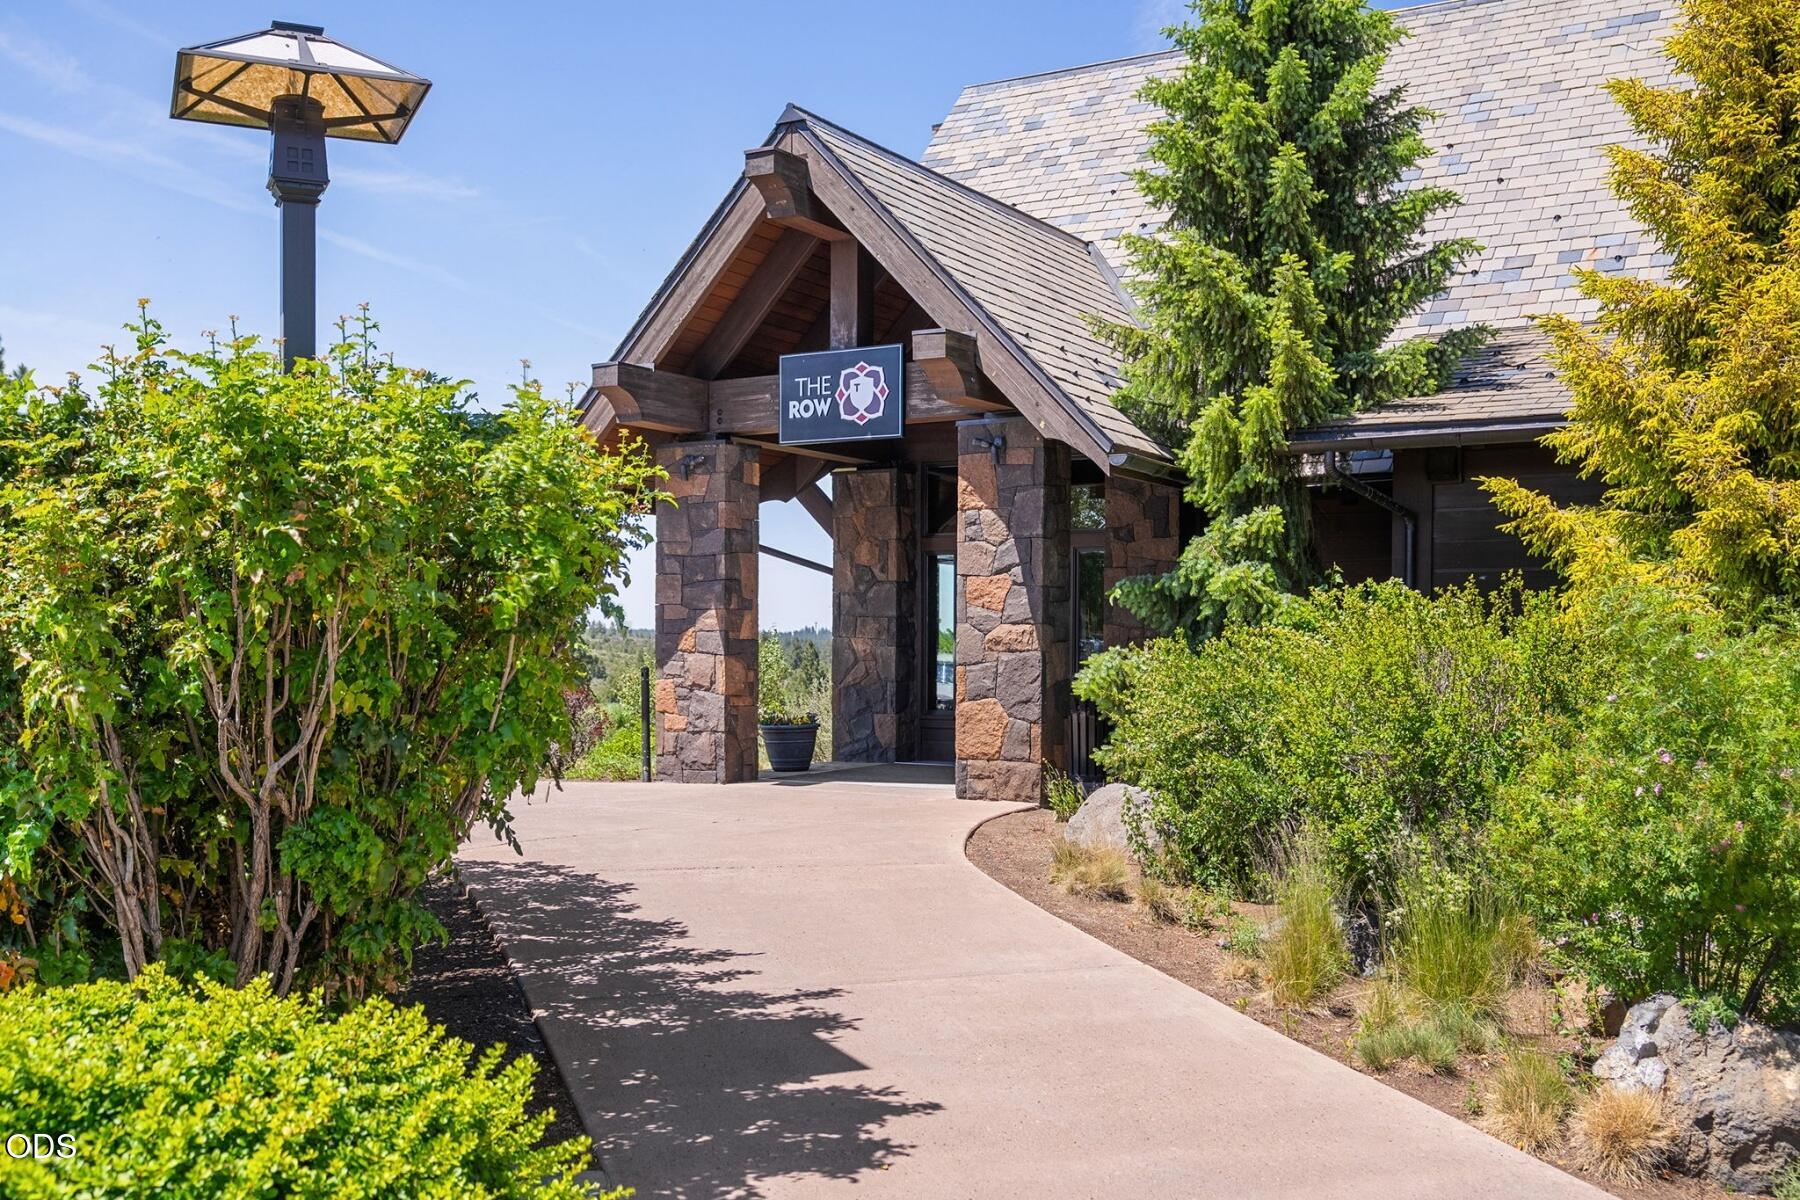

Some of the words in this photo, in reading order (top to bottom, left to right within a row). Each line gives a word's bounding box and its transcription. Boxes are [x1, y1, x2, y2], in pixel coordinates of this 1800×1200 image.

[795, 375, 832, 397] THE
[853, 383, 861, 393] T
[788, 398, 832, 419] ROW
